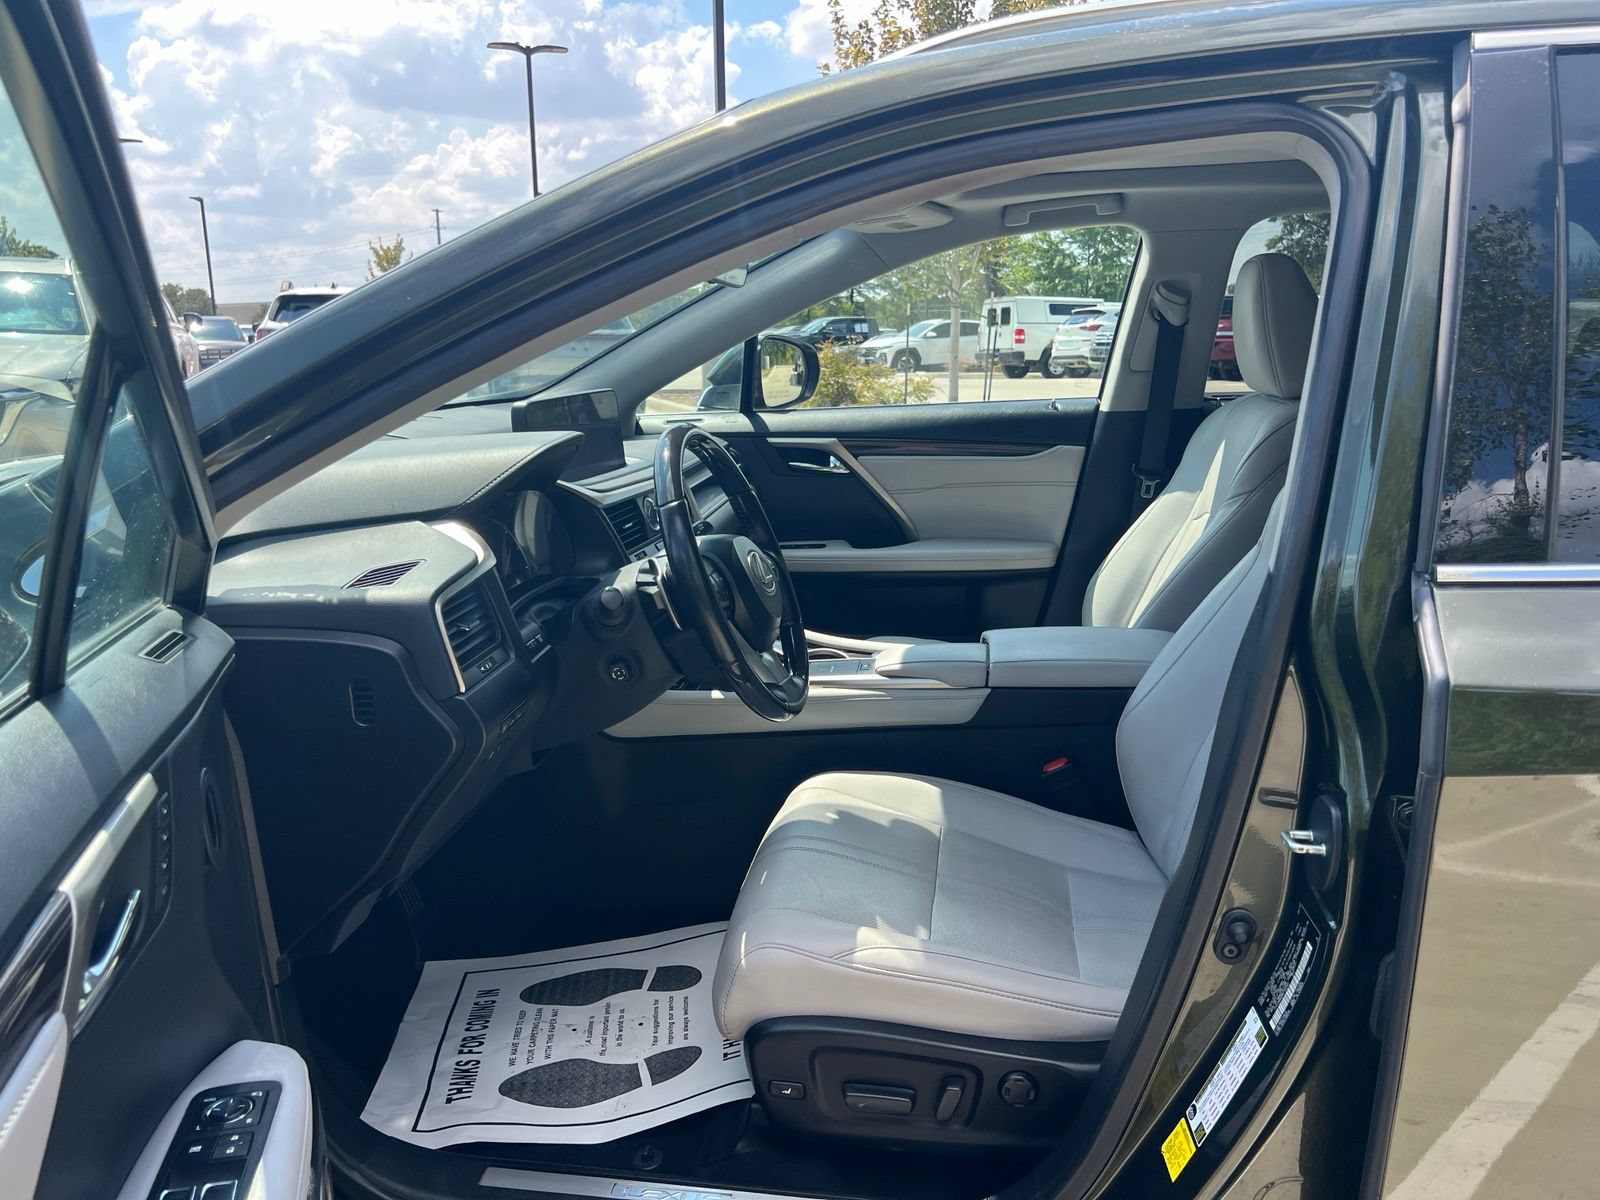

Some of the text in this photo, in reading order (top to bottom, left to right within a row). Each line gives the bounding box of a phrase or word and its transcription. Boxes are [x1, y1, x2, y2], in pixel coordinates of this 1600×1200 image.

[601, 1016, 610, 1035] important
[682, 1017, 690, 1032] always
[513, 1026, 523, 1041] TRIED
[526, 1007, 543, 1065] YOUR CARPETING CLEAN
[544, 1008, 560, 1060] WITH THIS PAPER MAT
[667, 1022, 675, 1045] improving
[445, 988, 501, 1105] THANKS FOR COMING IN
[510, 1042, 520, 1056] HAVE
[508, 1056, 517, 1067] WE
[722, 1050, 741, 1061] IT
